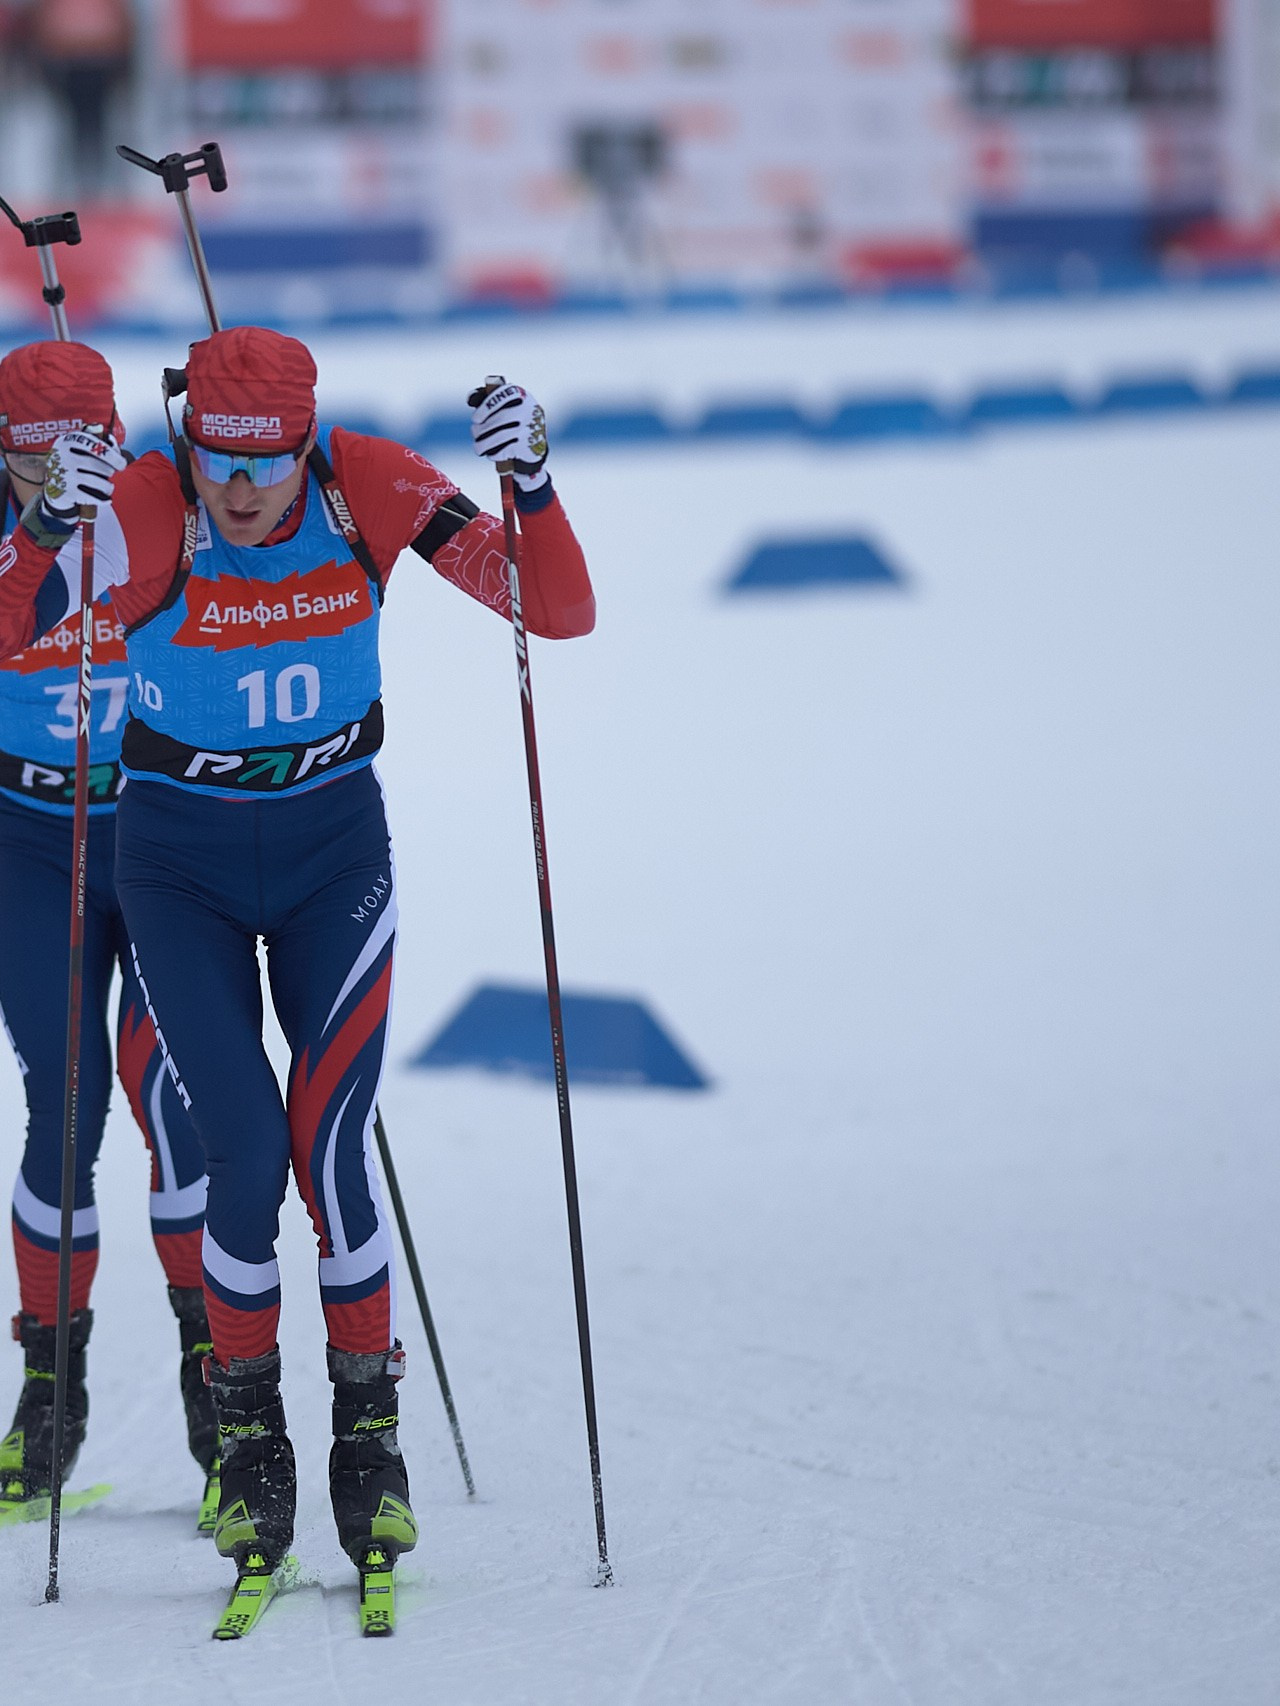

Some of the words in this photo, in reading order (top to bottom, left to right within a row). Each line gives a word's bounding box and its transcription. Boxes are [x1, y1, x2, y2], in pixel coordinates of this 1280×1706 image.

[10, 419, 83, 436] МОСОБЛ
[201, 414, 281, 428] МОСОБЛ
[202, 425, 263, 439] СПОРТ
[326, 489, 358, 534] SWIX
[183, 511, 197, 562] SWIX
[199, 600, 289, 633] Альфа
[292, 589, 359, 619] Банк
[509, 563, 531, 704] SWIX
[80, 603, 93, 742] SWIX
[134, 672, 163, 712] 10
[237, 663, 321, 729] 10
[44, 676, 129, 740] 37
[350, 874, 389, 923] MOAX
